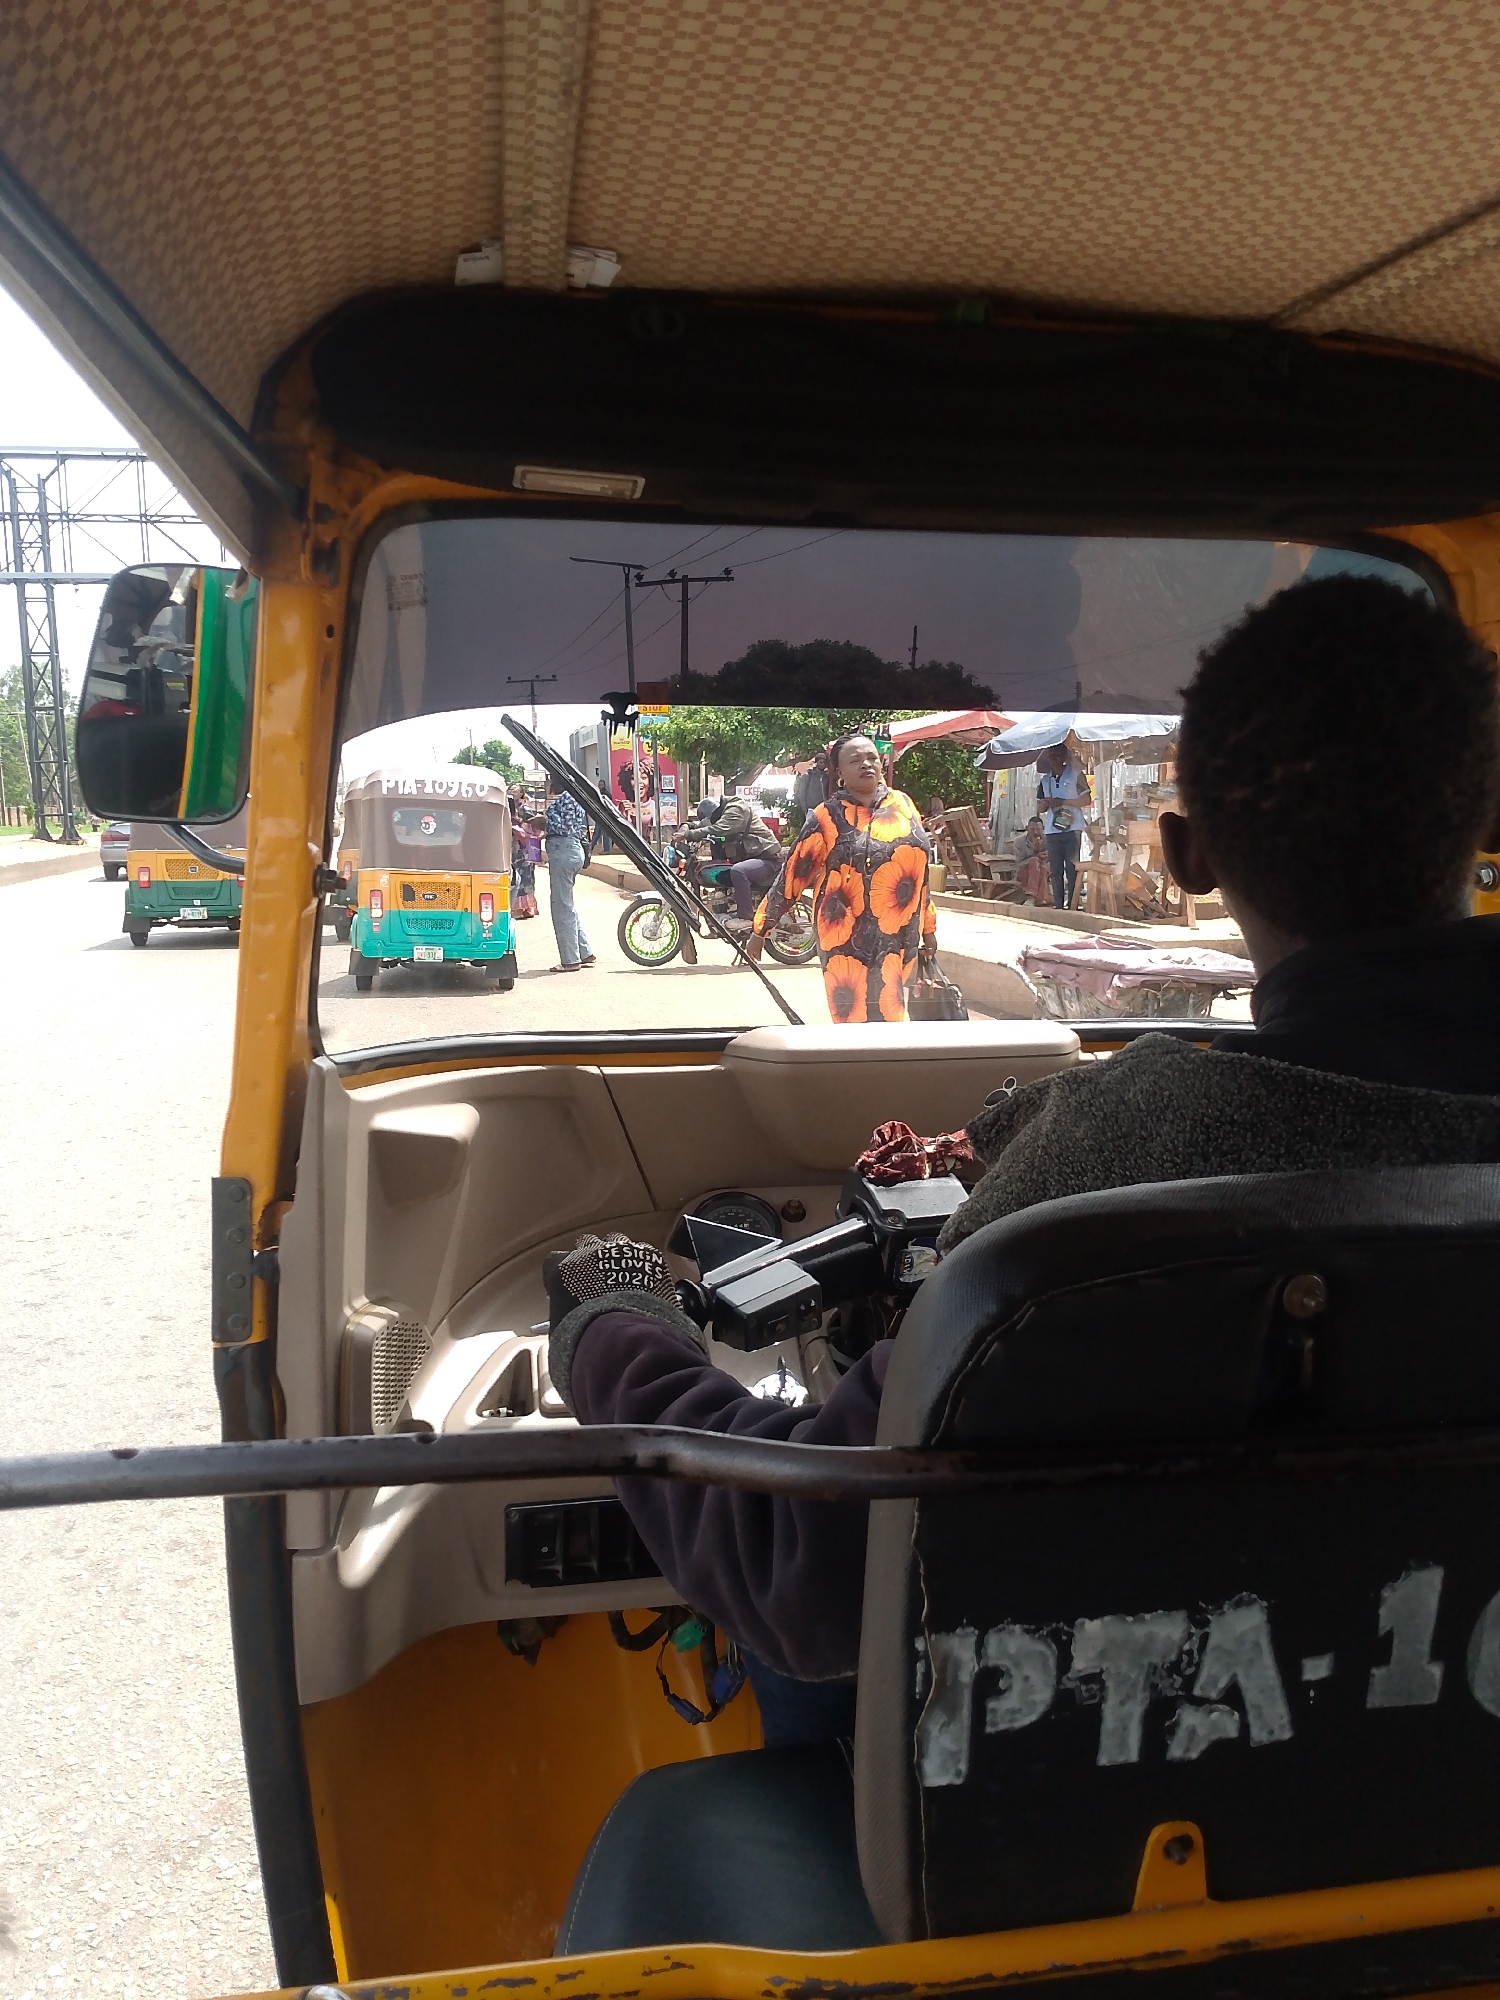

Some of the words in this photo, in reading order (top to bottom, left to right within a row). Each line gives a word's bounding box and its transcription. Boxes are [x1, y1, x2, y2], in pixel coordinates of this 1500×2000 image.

[598, 1247, 663, 1265] DESIGN
[599, 1259, 663, 1279] GLOVES
[606, 1271, 654, 1288] 2026
